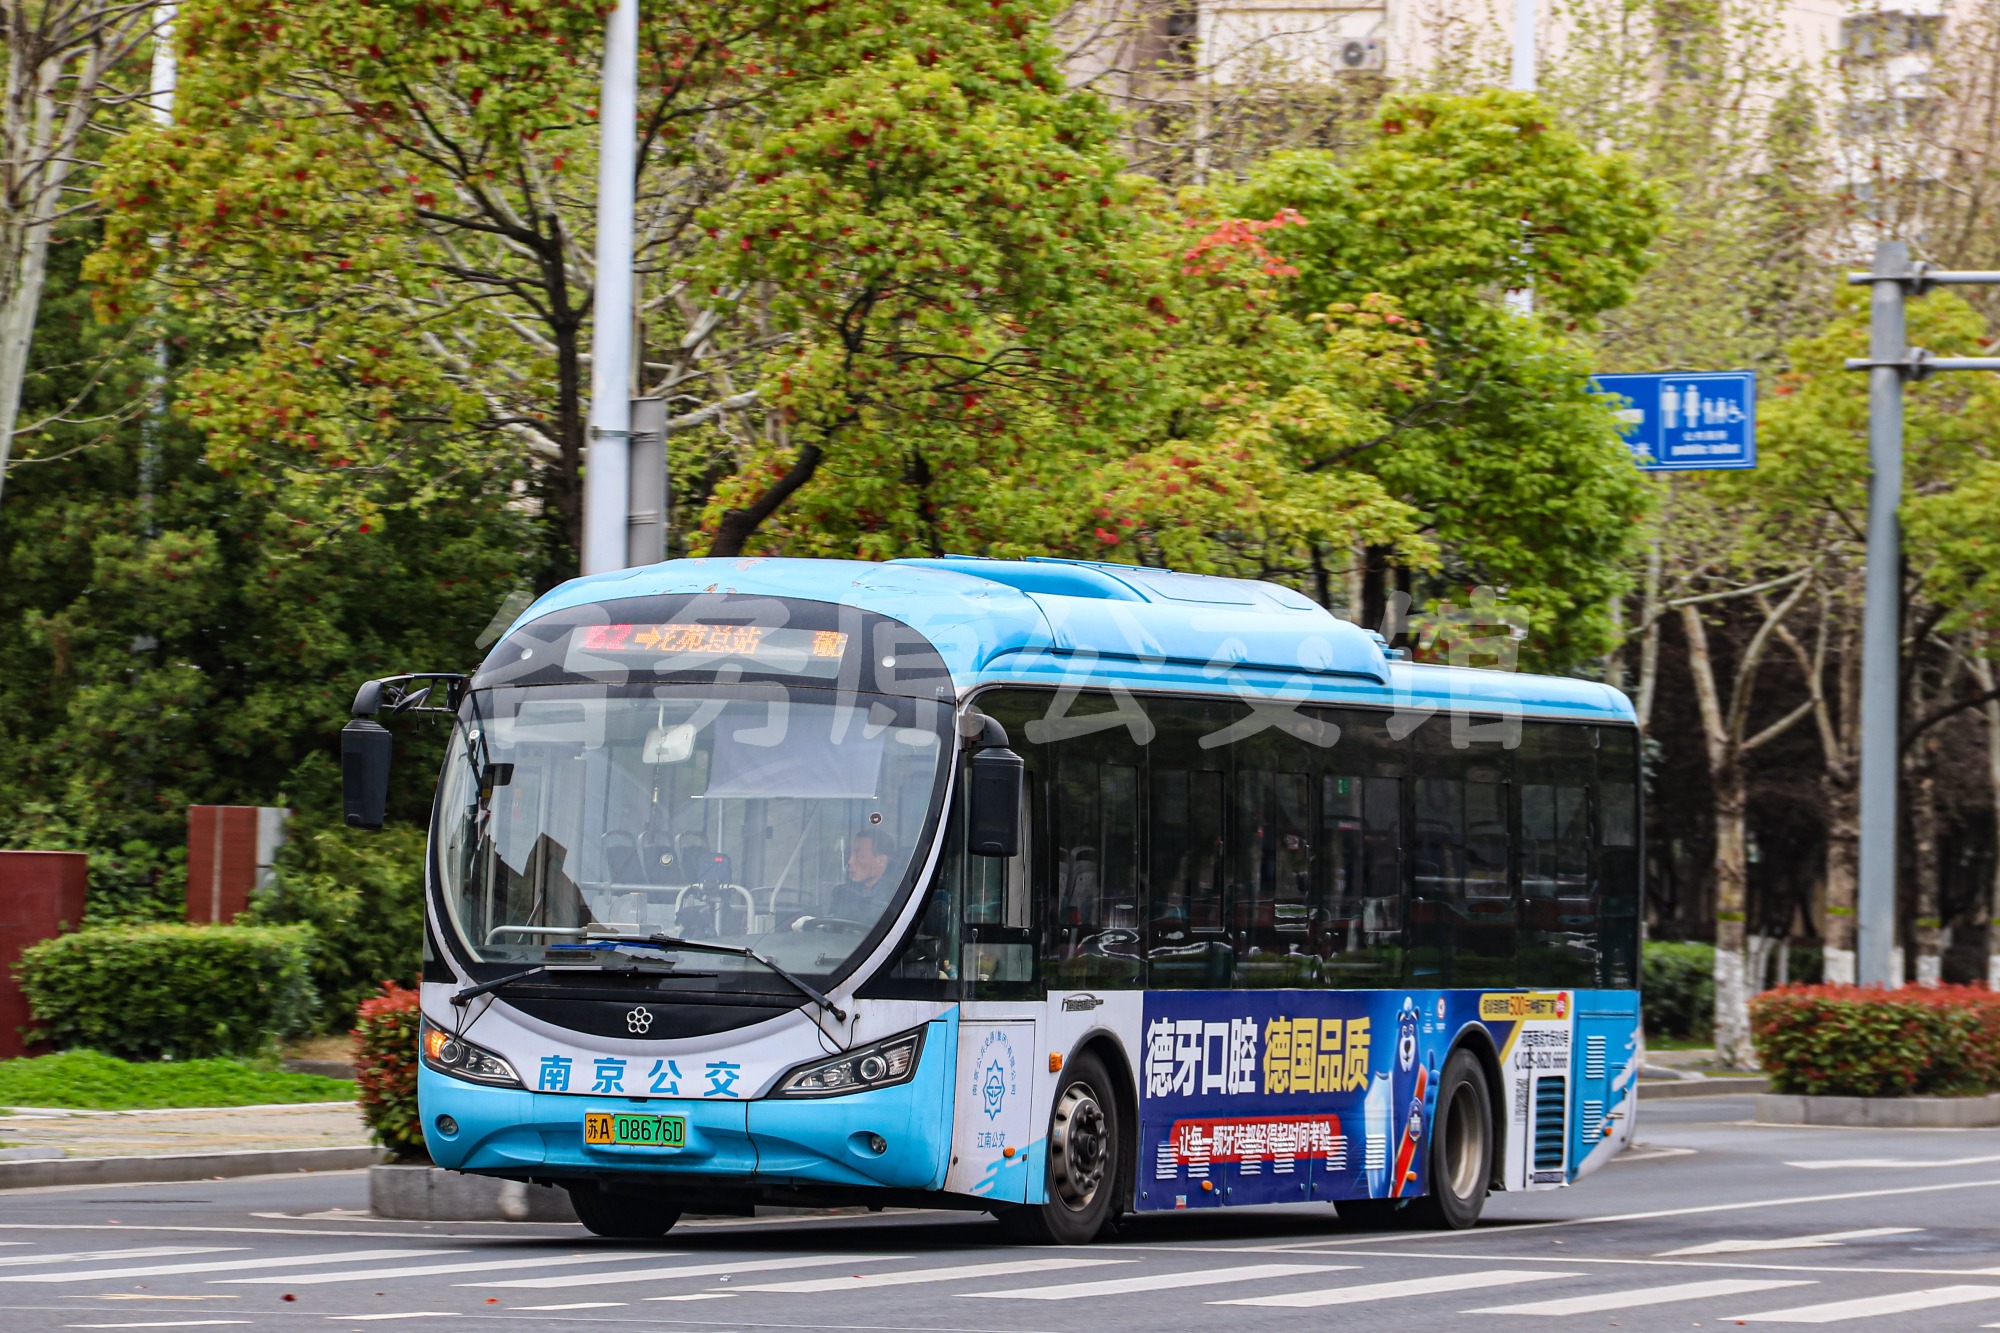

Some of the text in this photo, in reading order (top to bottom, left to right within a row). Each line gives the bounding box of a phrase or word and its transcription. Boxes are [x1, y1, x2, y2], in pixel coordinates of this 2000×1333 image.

[584, 624, 633, 650] 62
[1145, 1016, 1371, 1098] 德牙口腔 德国品质
[538, 1055, 741, 1098] 南京公交
[977, 1131, 1006, 1149] 江南公交
[1179, 1121, 1331, 1156] 让每一颗牙齿都经得起时间考验
